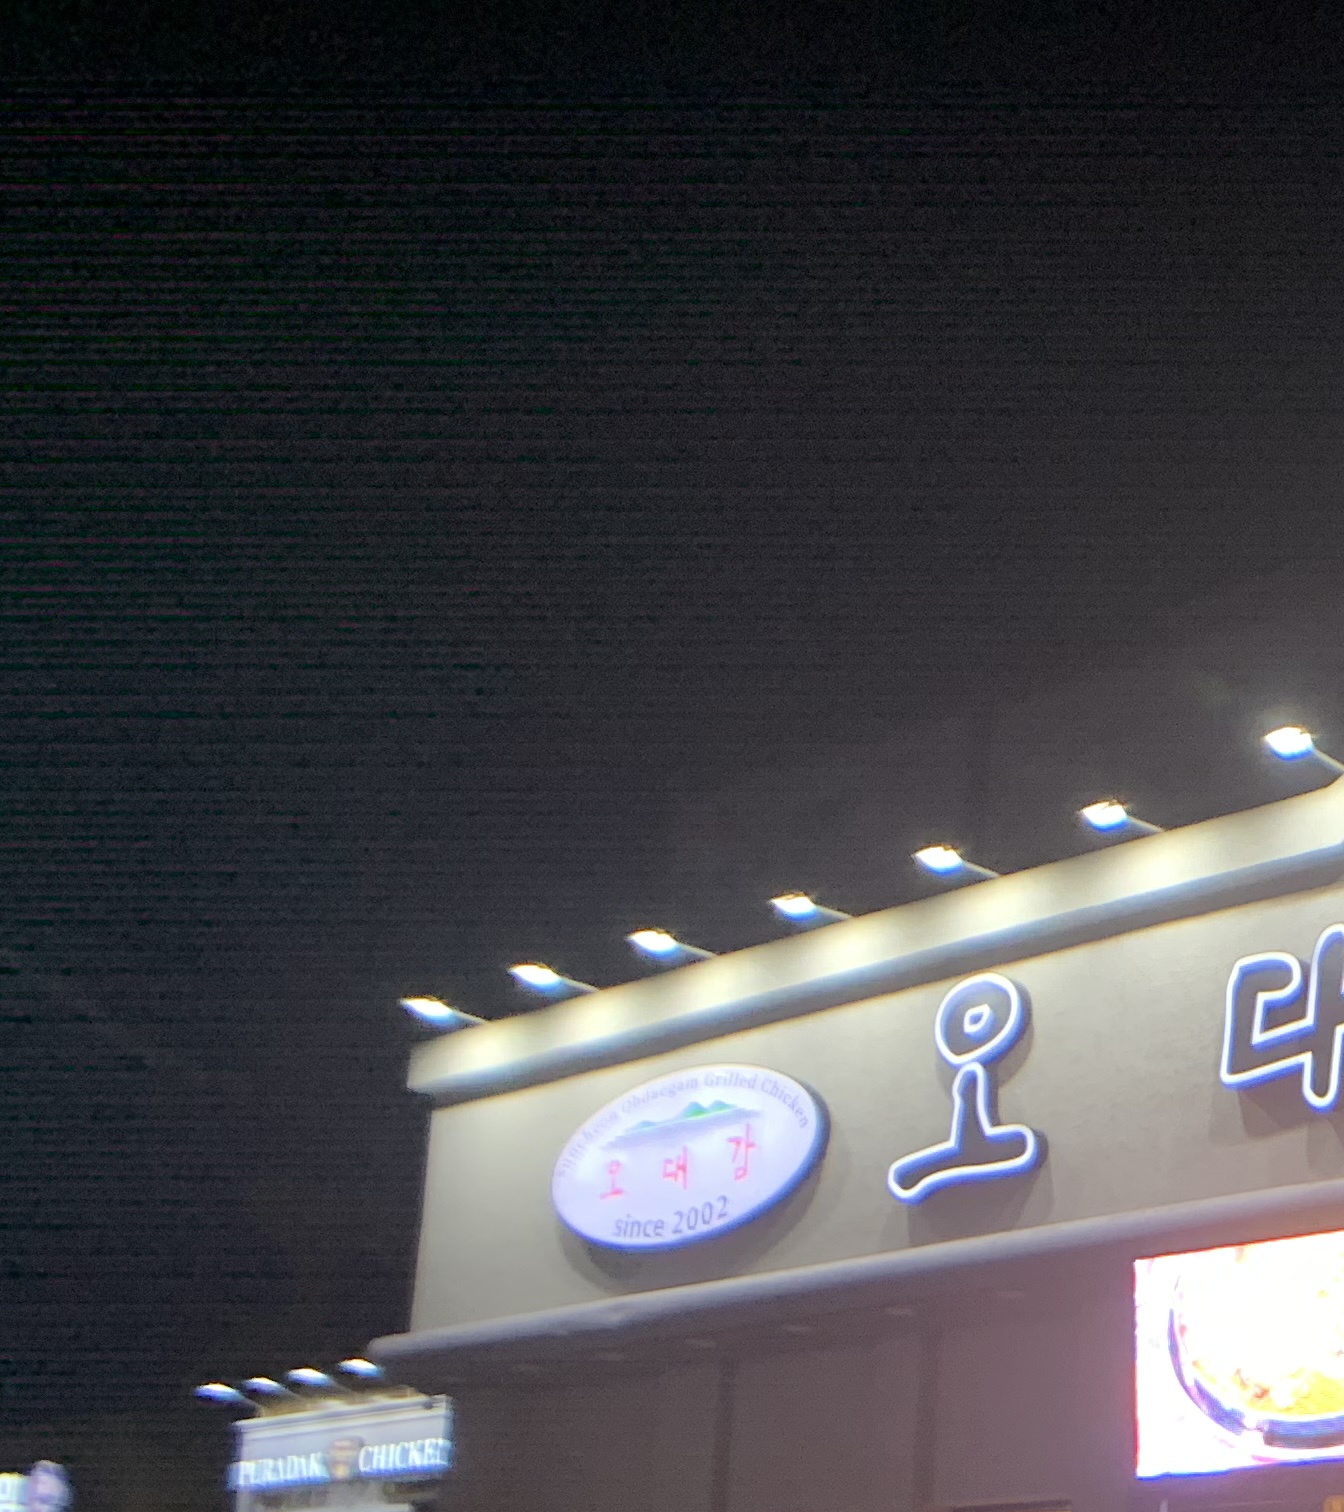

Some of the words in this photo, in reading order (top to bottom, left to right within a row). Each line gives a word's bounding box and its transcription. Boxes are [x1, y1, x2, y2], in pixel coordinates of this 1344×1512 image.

[703, 1071, 759, 1090] Grilled
[761, 1077, 809, 1129] Chicken
[612, 1212, 666, 1239] since
[671, 1195, 729, 1236] 2002
